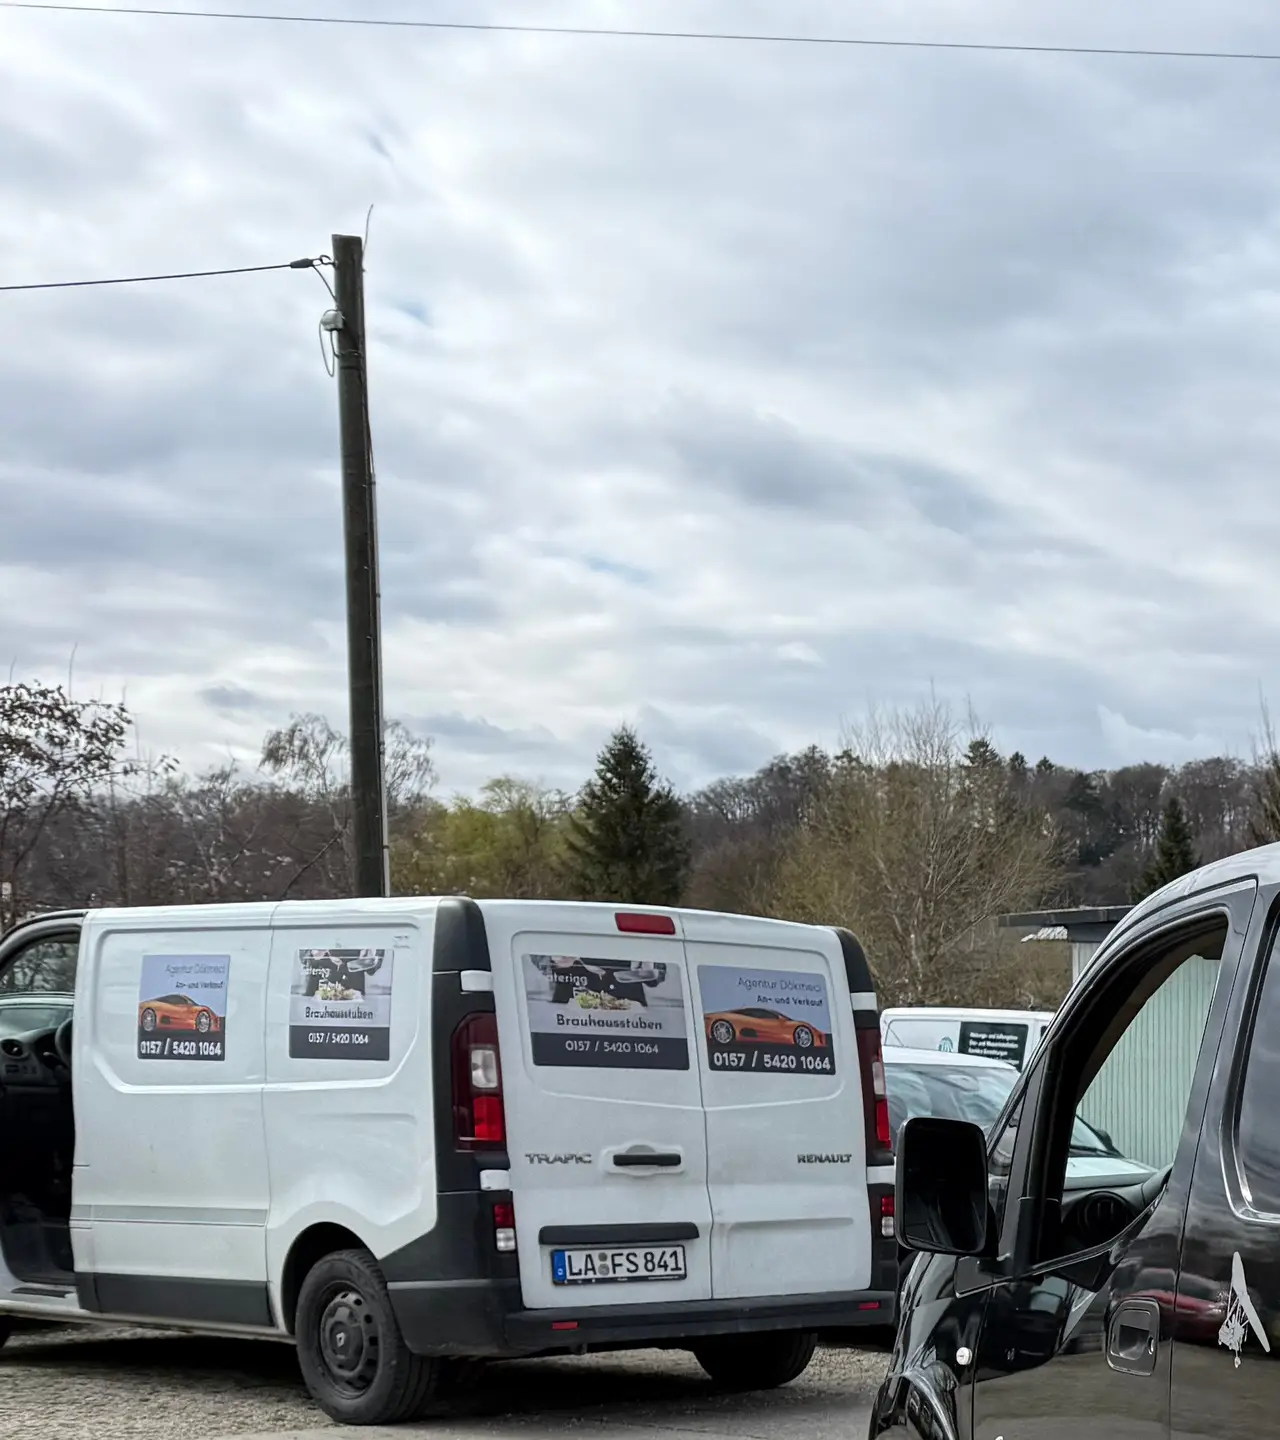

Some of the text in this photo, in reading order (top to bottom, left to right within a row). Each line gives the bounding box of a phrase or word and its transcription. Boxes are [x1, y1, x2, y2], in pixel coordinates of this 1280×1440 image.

[738, 977, 777, 990] Agentur
[775, 996, 790, 1004] und
[792, 997, 823, 1007] Verkauf
[305, 1006, 374, 1020] Brauhausstuben
[556, 1014, 663, 1030] Brauhausstuben
[308, 1032, 325, 1043] 0157
[331, 1034, 350, 1044] 5420
[352, 1034, 369, 1044] 1064
[140, 1041, 162, 1055] 0157
[172, 1041, 197, 1055] 5420
[199, 1042, 222, 1056] 1064
[565, 1040, 590, 1051] 0157
[603, 1041, 631, 1053] 5420
[634, 1042, 659, 1054] 1064
[713, 1050, 831, 1070] 0157 / 5420 1064
[797, 1153, 853, 1164] RENAULT
[567, 1250, 683, 1277] LA FS 841
